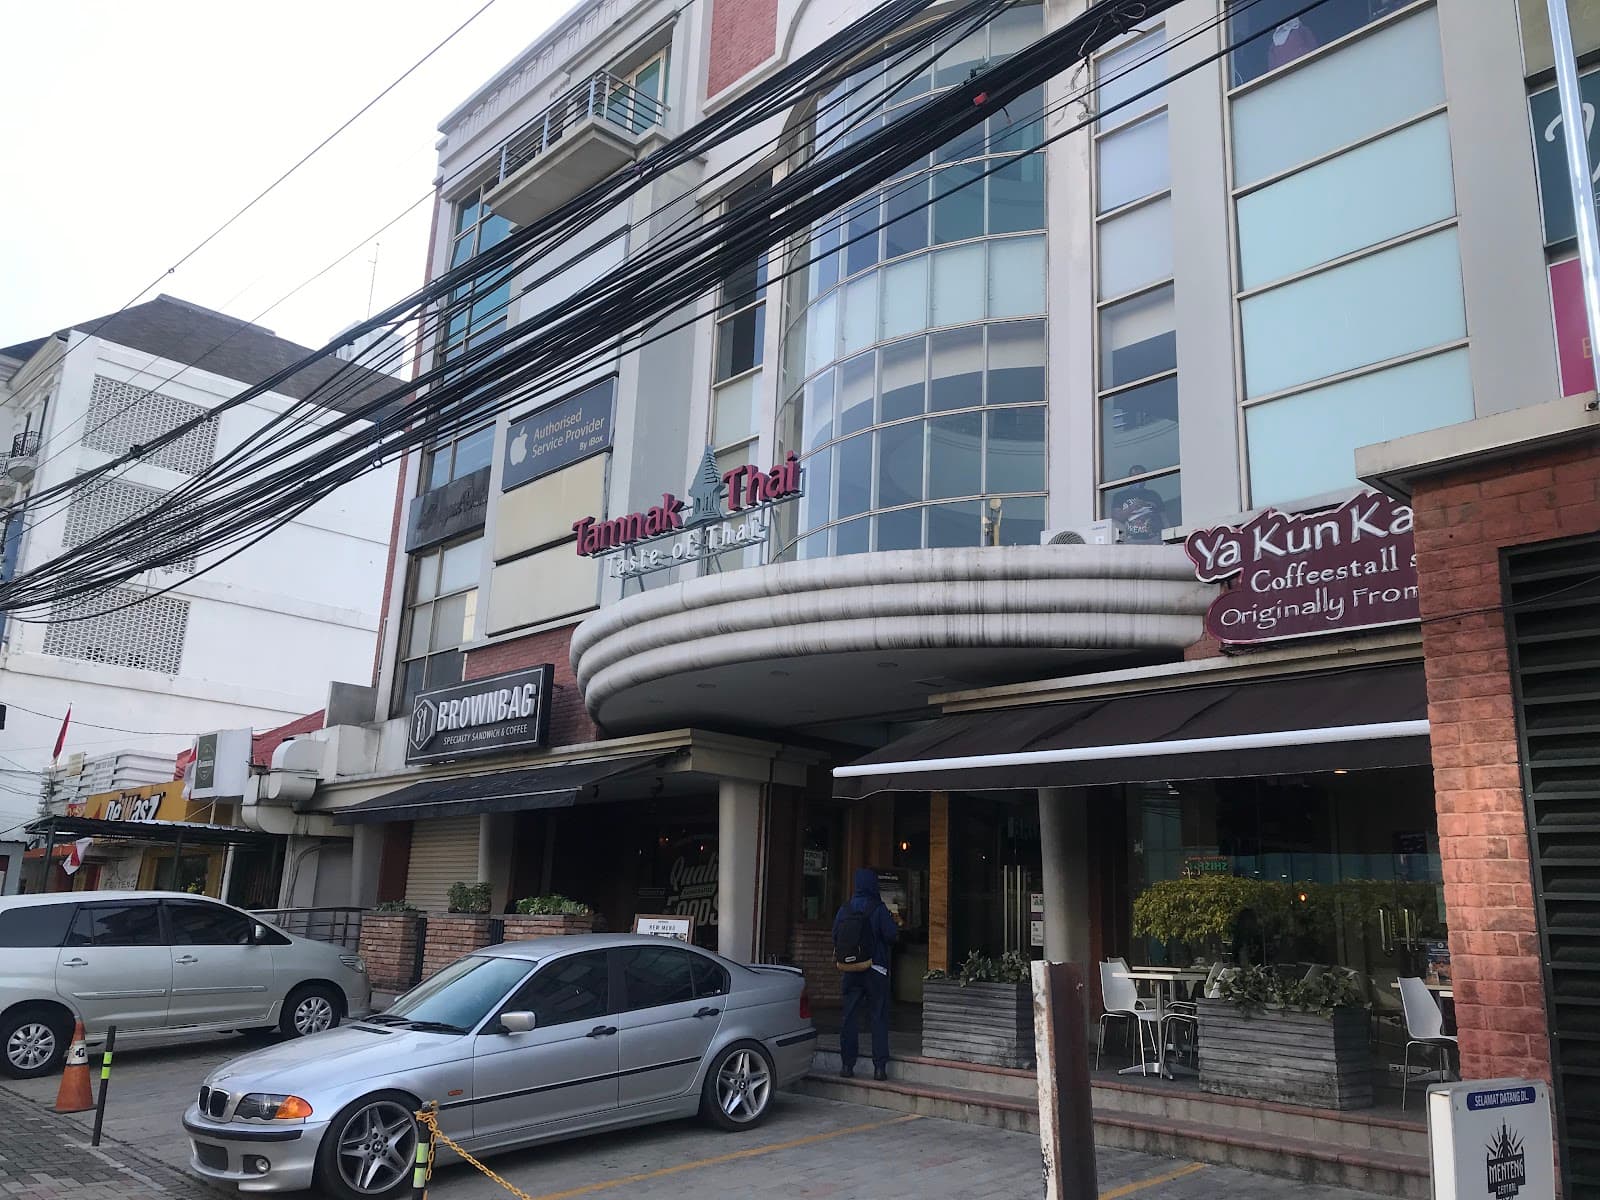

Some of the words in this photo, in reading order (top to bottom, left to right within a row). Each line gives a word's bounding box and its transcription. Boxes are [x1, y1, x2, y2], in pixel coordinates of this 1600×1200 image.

[532, 436, 563, 458] Service
[565, 416, 605, 443] Provider
[533, 408, 583, 441] Authorised
[579, 441, 588, 451] By
[572, 492, 685, 556] Tamnak
[722, 450, 803, 512] Thai
[606, 546, 660, 578] Taste
[672, 530, 700, 559] of
[1194, 534, 1242, 571] Ya
[1252, 519, 1341, 562] Kun
[1251, 544, 1398, 593] Coffeestall
[1220, 587, 1345, 630] Originally
[1353, 584, 1418, 608] From
[436, 683, 537, 732] BROWNBAG
[443, 733, 472, 745] SPECIALTY
[472, 728, 501, 741] SANDWICH
[505, 724, 528, 736] COFFEE
[1474, 1093, 1499, 1107] SELAMAT
[1499, 1091, 1520, 1104] DATANG
[1488, 1158, 1524, 1185] MENTENG
